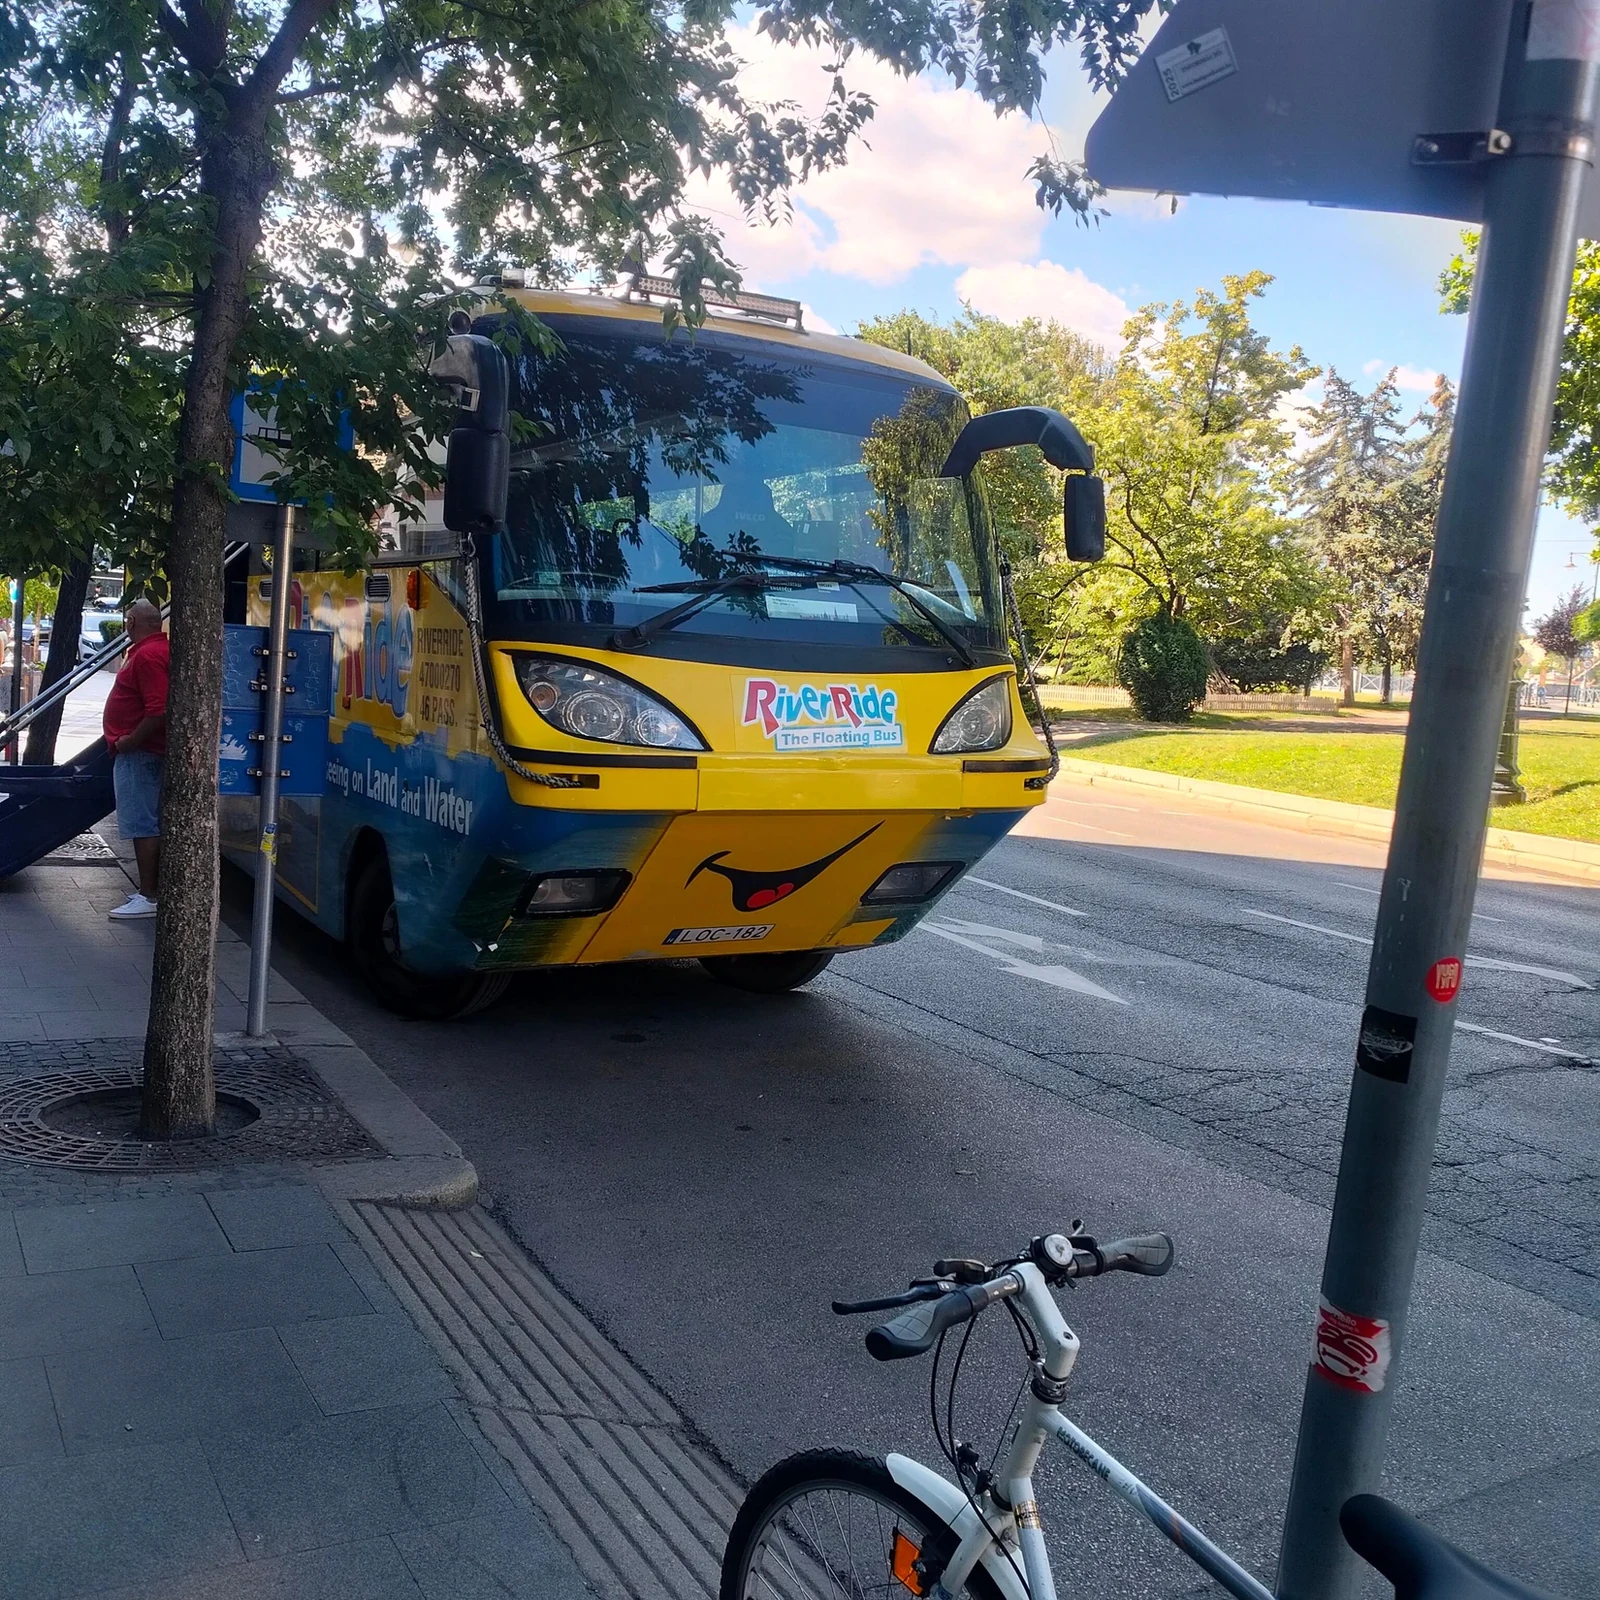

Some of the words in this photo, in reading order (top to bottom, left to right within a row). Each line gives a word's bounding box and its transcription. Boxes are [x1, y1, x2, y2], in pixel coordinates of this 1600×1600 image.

[1162, 68, 1180, 97] 2025
[735, 511, 766, 522] IVECO
[416, 627, 464, 657] RIVERRIDE
[418, 661, 462, 693] 47000270
[419, 694, 431, 722] 46
[431, 696, 459, 727] PASS.
[743, 679, 897, 737] RiverRide
[781, 732, 809, 746] The
[812, 730, 870, 748] Floating
[873, 728, 897, 742] Bus
[352, 768, 364, 794] on
[366, 757, 398, 808] Land
[401, 785, 420, 818] and
[424, 775, 473, 836] Water
[680, 926, 768, 943] LOC-182
[1056, 1426, 1111, 1483] MOTOBECANE
